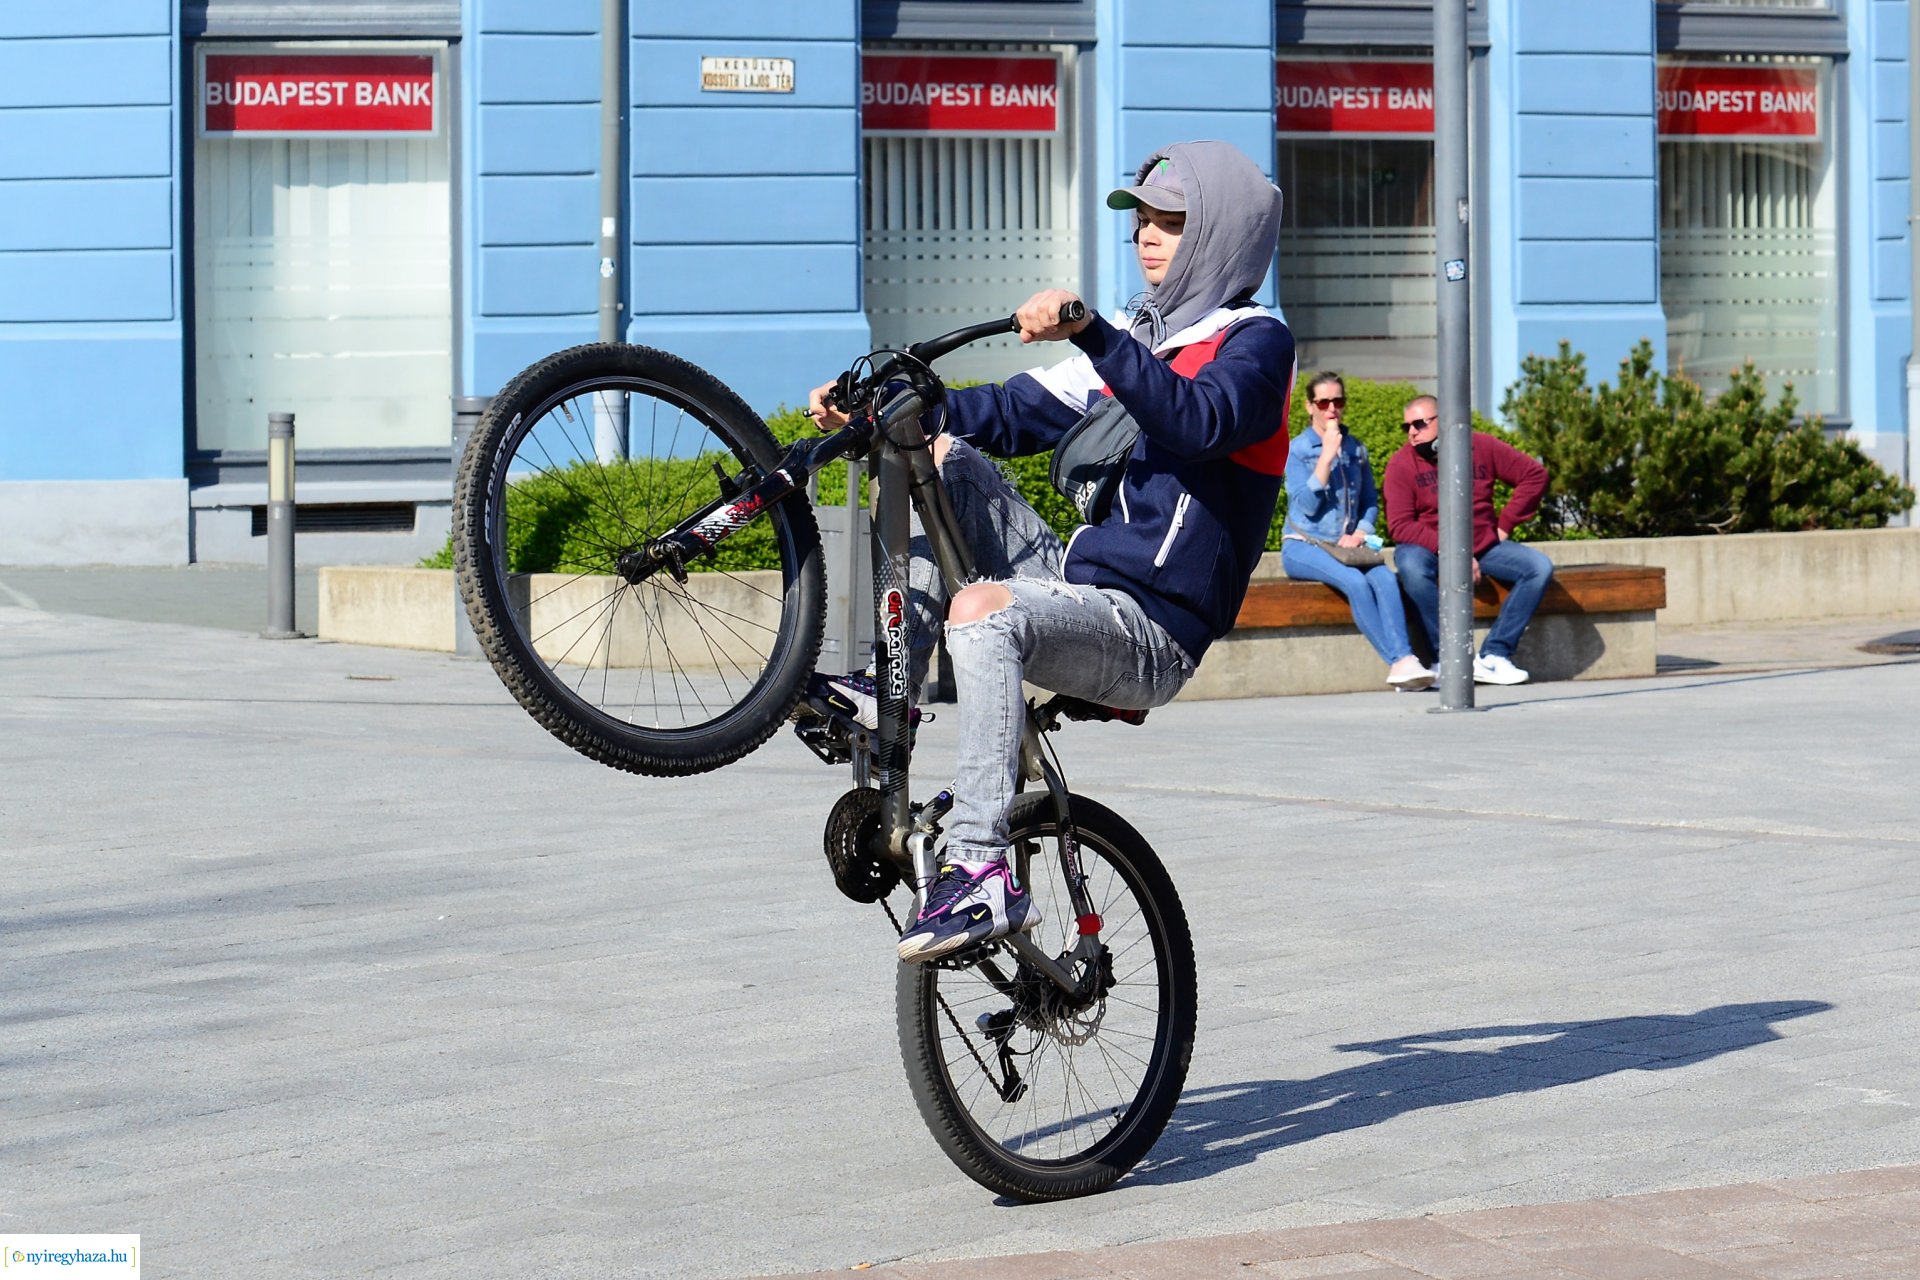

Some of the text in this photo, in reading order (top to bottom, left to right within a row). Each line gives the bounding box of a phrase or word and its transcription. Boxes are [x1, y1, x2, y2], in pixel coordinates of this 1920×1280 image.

[703, 72, 791, 88] KOSSUTH LAJOS TÉR
[206, 81, 431, 107] BUDAPEST BANK
[862, 82, 1056, 107] BUDAPEST BANK
[1388, 88, 1434, 110] BAN
[1760, 91, 1815, 113] BANK
